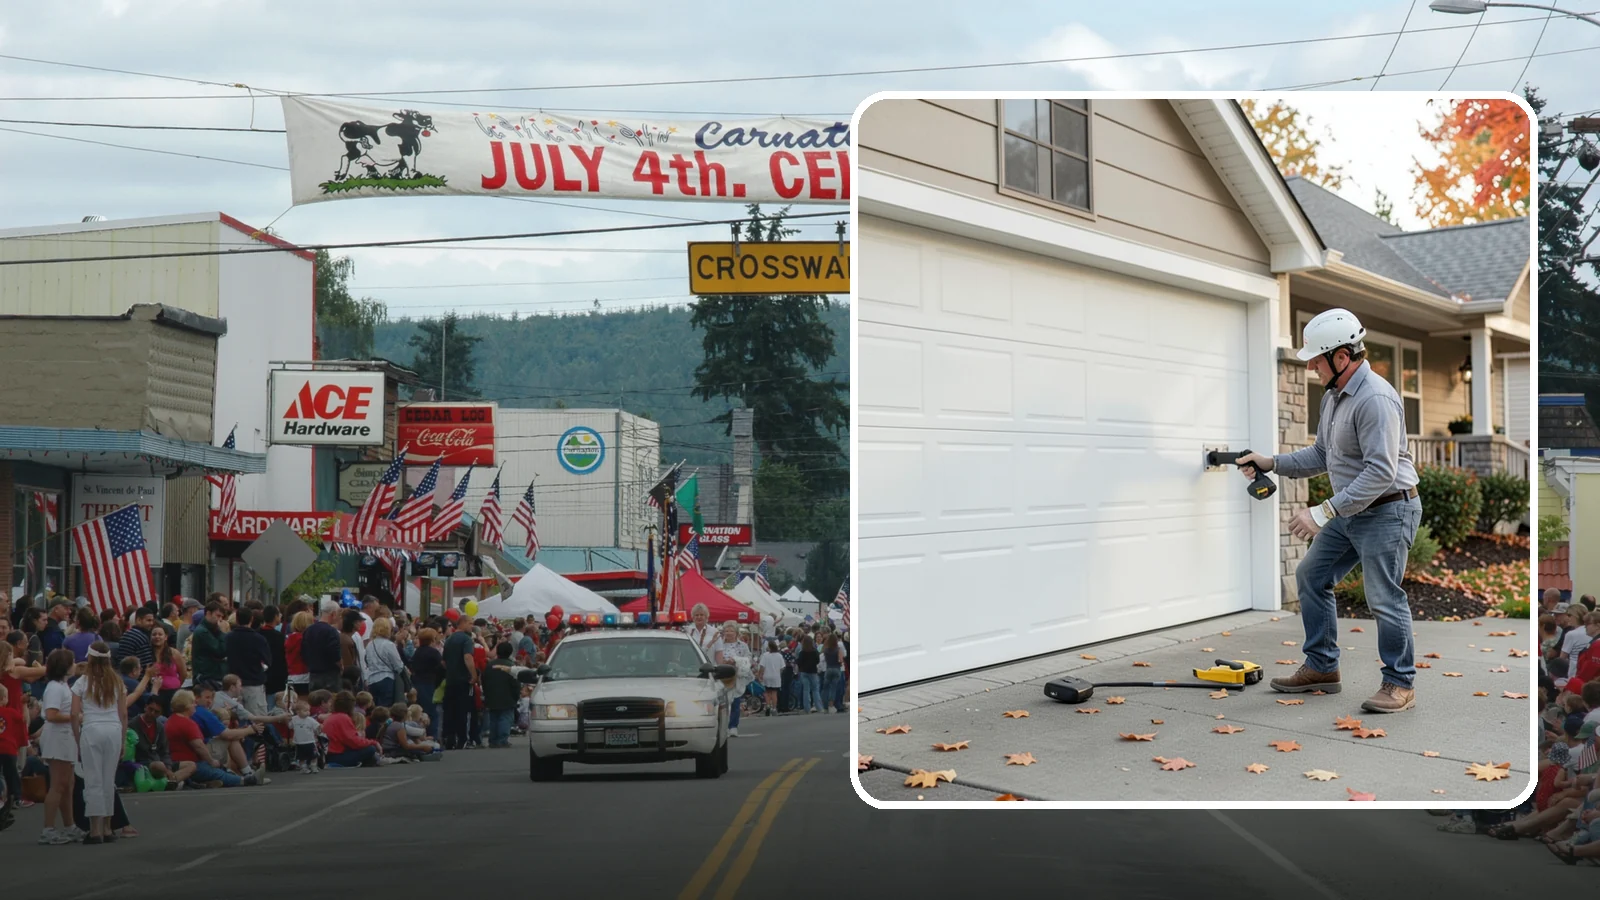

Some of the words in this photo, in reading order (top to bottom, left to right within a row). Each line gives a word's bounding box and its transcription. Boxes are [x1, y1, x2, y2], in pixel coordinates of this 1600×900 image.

[695, 121, 850, 150] Carnat
[481, 140, 605, 193] JULY
[632, 149, 747, 198] 4th.
[697, 254, 850, 280] CROSSWA
[282, 379, 374, 420] ACE
[406, 409, 452, 422] CEDAR
[461, 409, 485, 421] LOG
[283, 421, 371, 437] Hardware
[416, 428, 477, 447] Coca-Cola
[354, 467, 384, 480] Simpl
[96, 485, 124, 495] Vincent
[126, 486, 136, 495] de
[137, 486, 155, 496] Paul
[688, 526, 741, 535] CRNATION
[699, 535, 730, 543] GLASS
